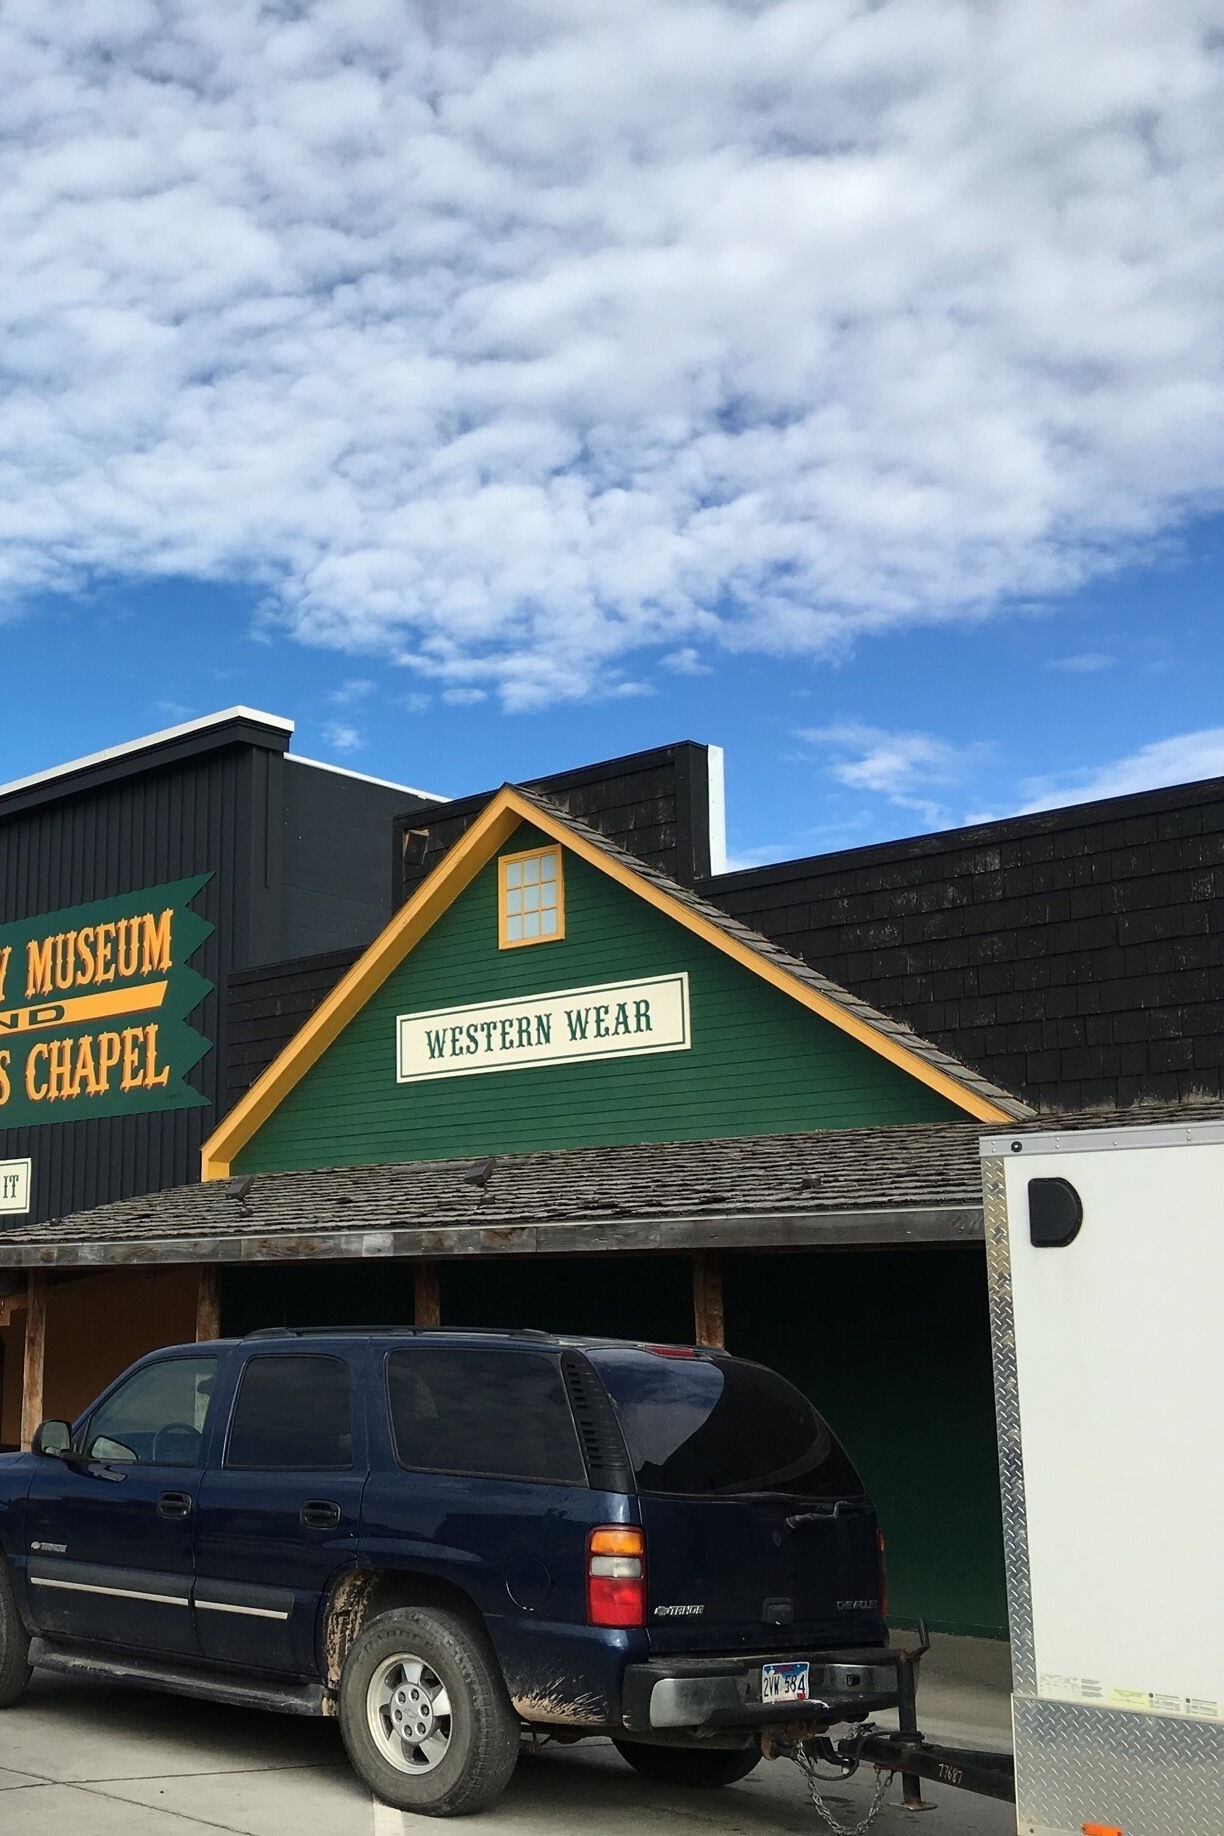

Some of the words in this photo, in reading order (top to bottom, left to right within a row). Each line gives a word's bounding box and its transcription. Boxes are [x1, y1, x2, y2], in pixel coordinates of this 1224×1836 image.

[24, 907, 175, 998] MUSEUM
[24, 1022, 172, 1102] CHAPEL
[425, 1012, 553, 1060] WESTERN
[563, 998, 653, 1042] WEAR
[2, 1174, 19, 1199] IT
